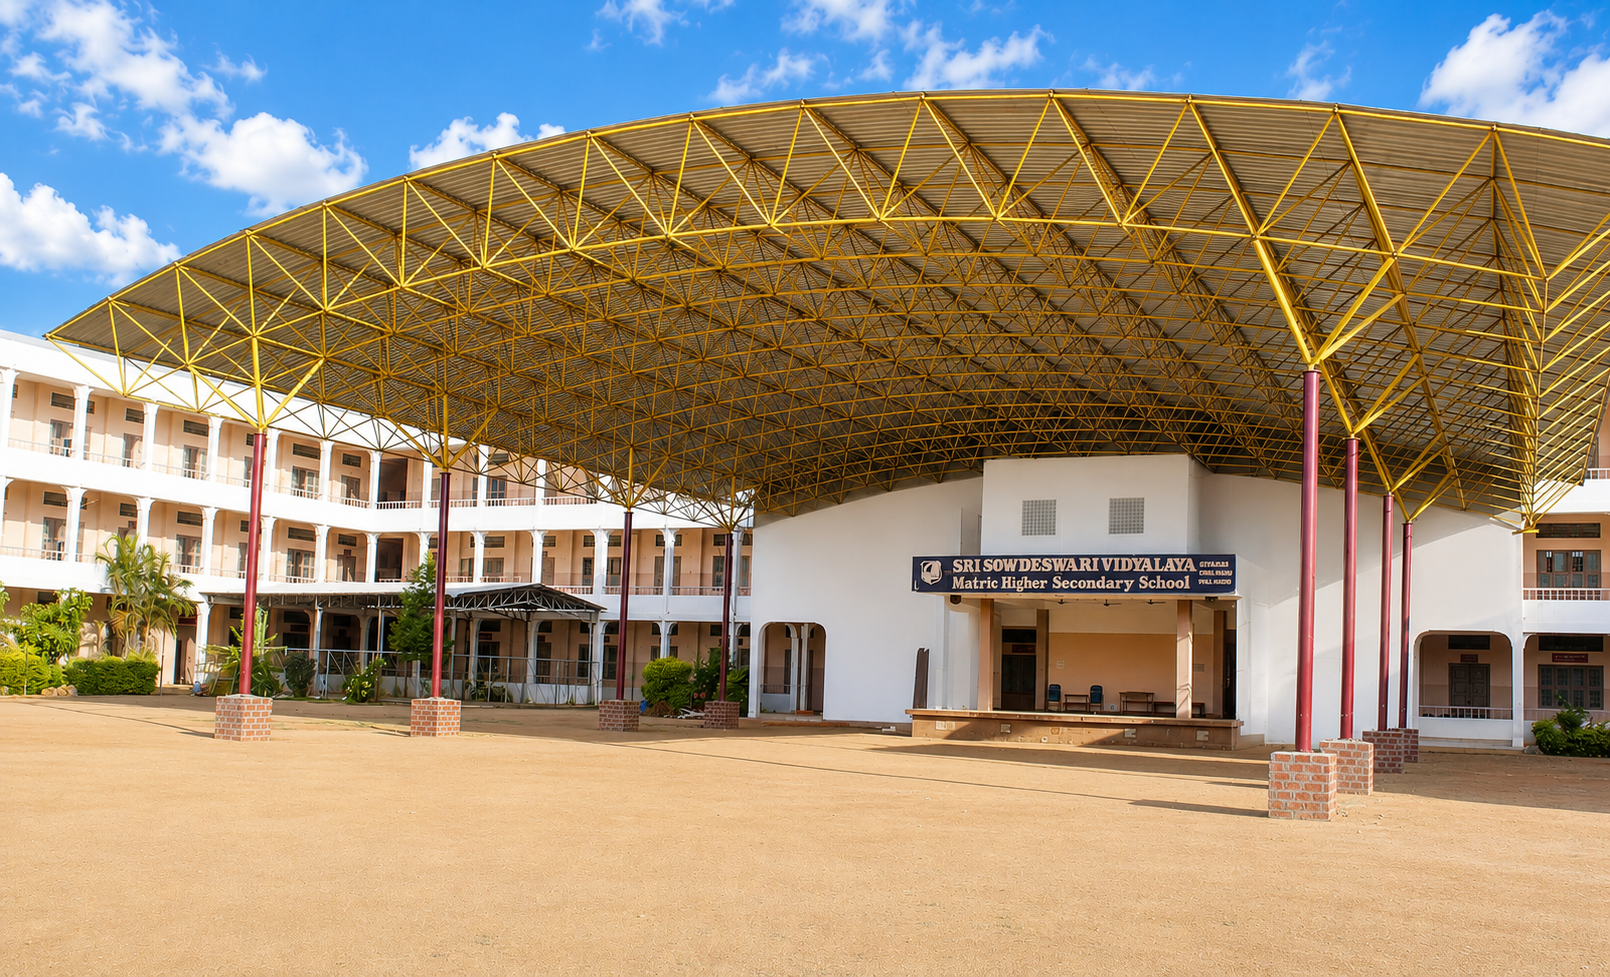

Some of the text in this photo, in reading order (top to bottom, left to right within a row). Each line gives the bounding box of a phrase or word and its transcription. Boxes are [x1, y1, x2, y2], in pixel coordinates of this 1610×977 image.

[952, 559, 980, 572] SRI
[1102, 558, 1197, 572] VIDYALAYA
[952, 576, 998, 589] Matric
[1001, 576, 1047, 592] Higher
[1053, 576, 1134, 592] Secondary
[1139, 575, 1190, 589] School
